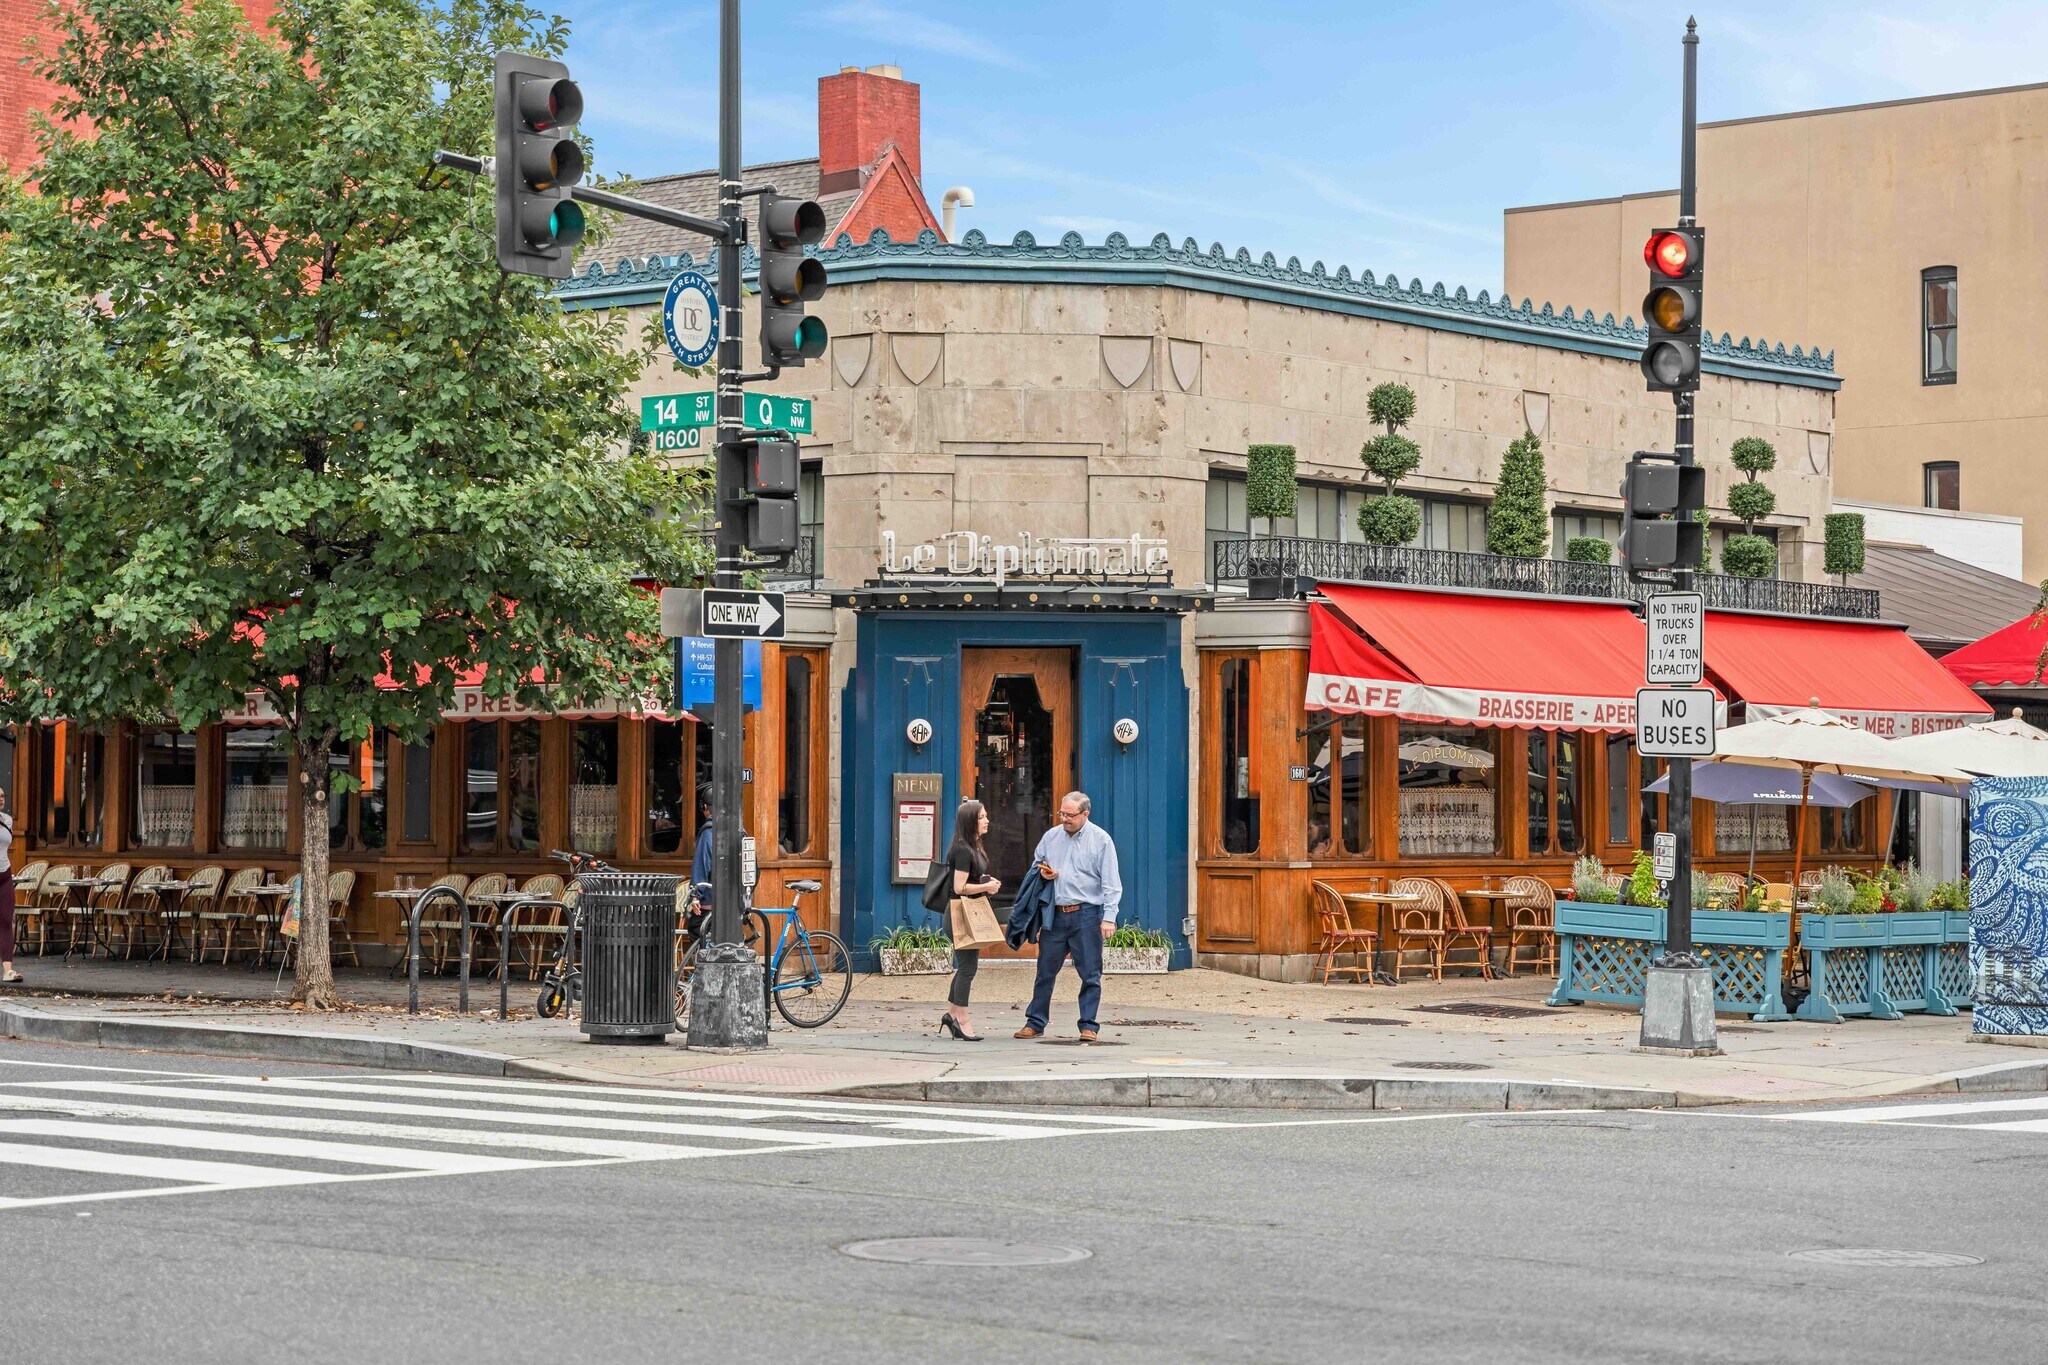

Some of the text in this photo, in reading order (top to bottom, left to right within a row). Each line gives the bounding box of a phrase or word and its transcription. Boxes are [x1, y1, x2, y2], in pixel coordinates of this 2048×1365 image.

[672, 275, 713, 299] GREATER
[683, 307, 704, 332] DC
[667, 327, 716, 363] 14TH STREET
[654, 396, 709, 425] 14 ST
[695, 410, 710, 422] NW
[759, 399, 804, 426] Q ST
[790, 416, 805, 428] NW
[657, 428, 699, 449] 1600
[882, 530, 1168, 588] Le Diplomate
[711, 604, 759, 623] ONE WAY
[1653, 603, 1697, 615] NO THRU
[1656, 618, 1694, 629] TRUCKS
[1662, 634, 1687, 645] OVER
[1650, 648, 1699, 661] 1 1/4 TON
[1650, 664, 1698, 675] CAPACITY
[1324, 682, 1402, 709] CAFE
[1478, 697, 1574, 722] BRASSERIE
[1662, 699, 1687, 718] NO
[1865, 716, 1895, 735] MER
[1911, 717, 1965, 735] BISTRO
[1644, 726, 1706, 745] BUSES
[1405, 747, 1488, 777] LE DIPLOMATE
[897, 779, 939, 792] MENU
